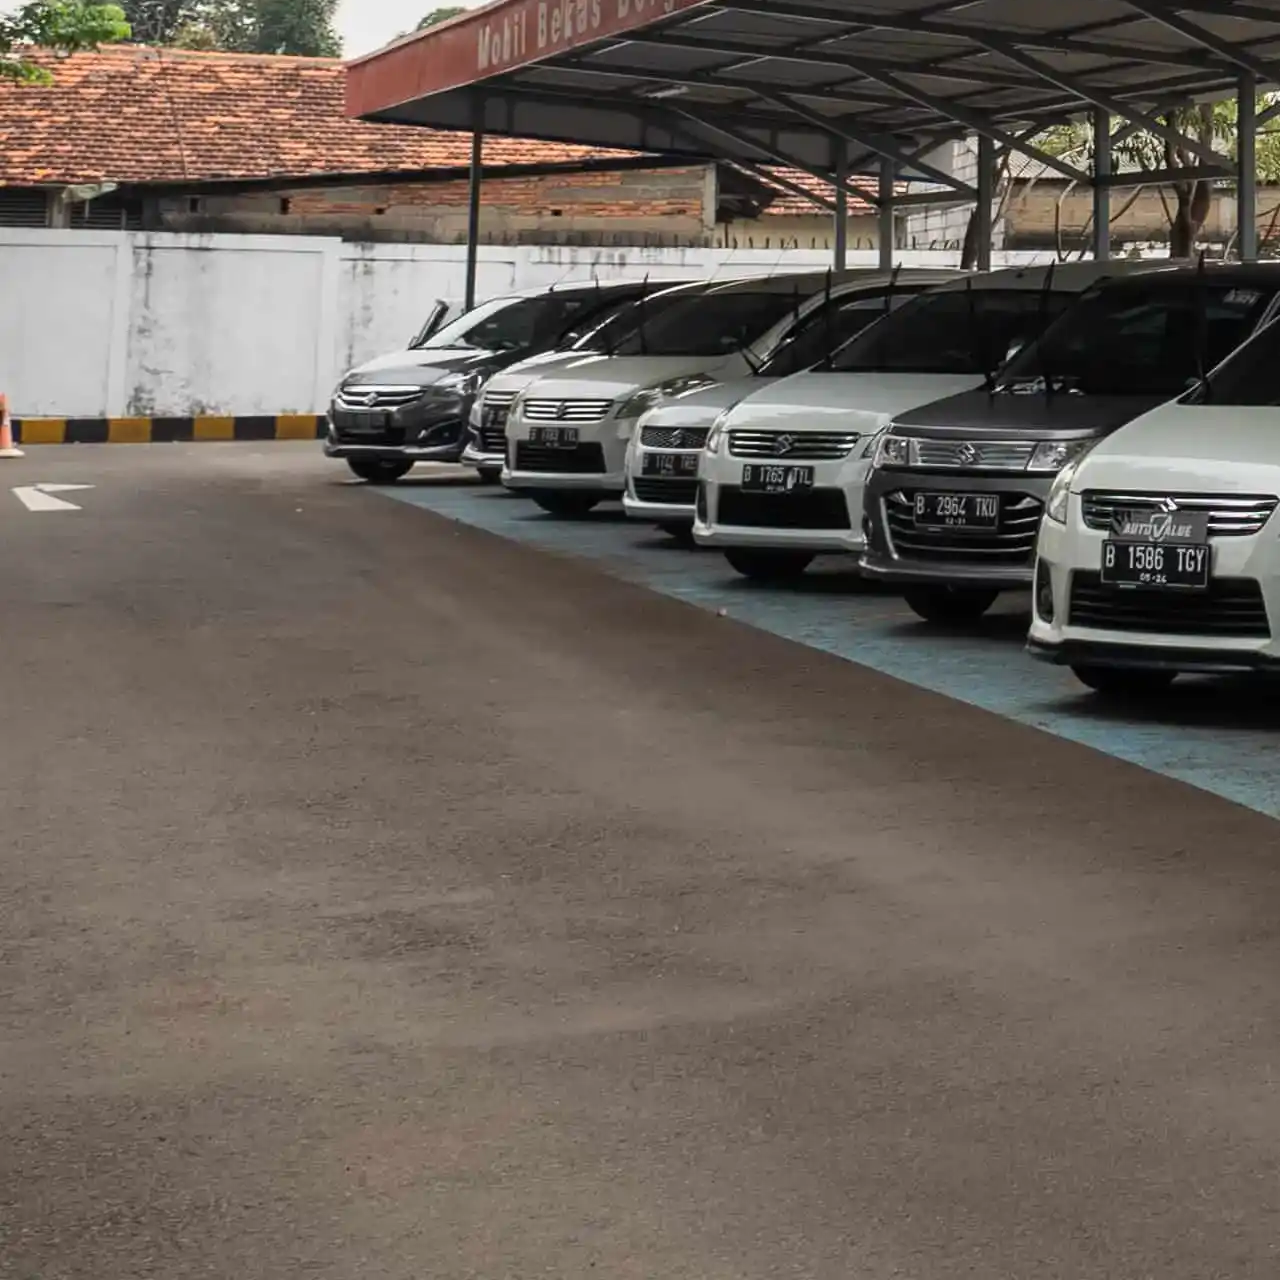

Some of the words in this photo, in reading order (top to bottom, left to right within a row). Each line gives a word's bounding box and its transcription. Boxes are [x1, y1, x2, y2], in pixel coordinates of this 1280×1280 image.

[477, 10, 526, 71] Mobil
[744, 466, 752, 482] B
[760, 466, 784, 483] 1765
[916, 495, 925, 514] B
[936, 496, 966, 516] 2964
[975, 497, 997, 517] TKU
[1105, 545, 1115, 567] B
[1128, 546, 1164, 570] 1586
[1176, 548, 1205, 572] TGY
